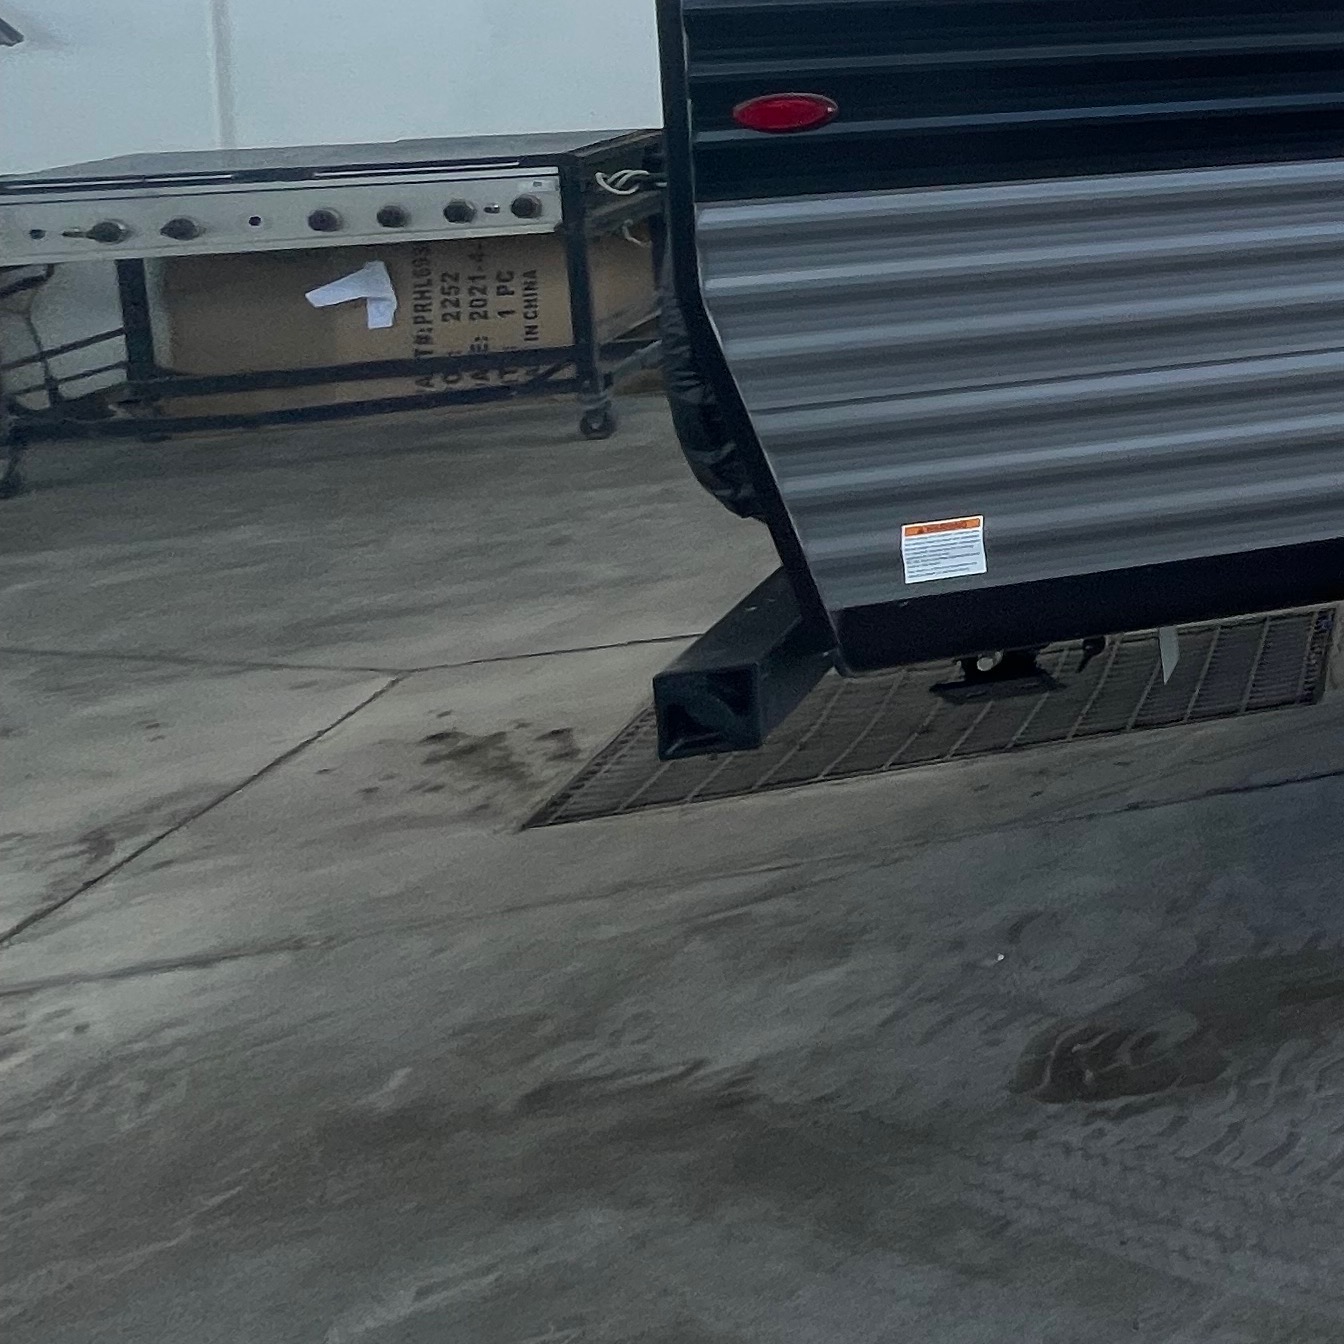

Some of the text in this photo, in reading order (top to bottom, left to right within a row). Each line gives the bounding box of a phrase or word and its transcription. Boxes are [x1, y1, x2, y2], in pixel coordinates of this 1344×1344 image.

[441, 271, 461, 322] 2252
[496, 270, 515, 297] PC
[522, 269, 539, 342] IN CHINA
